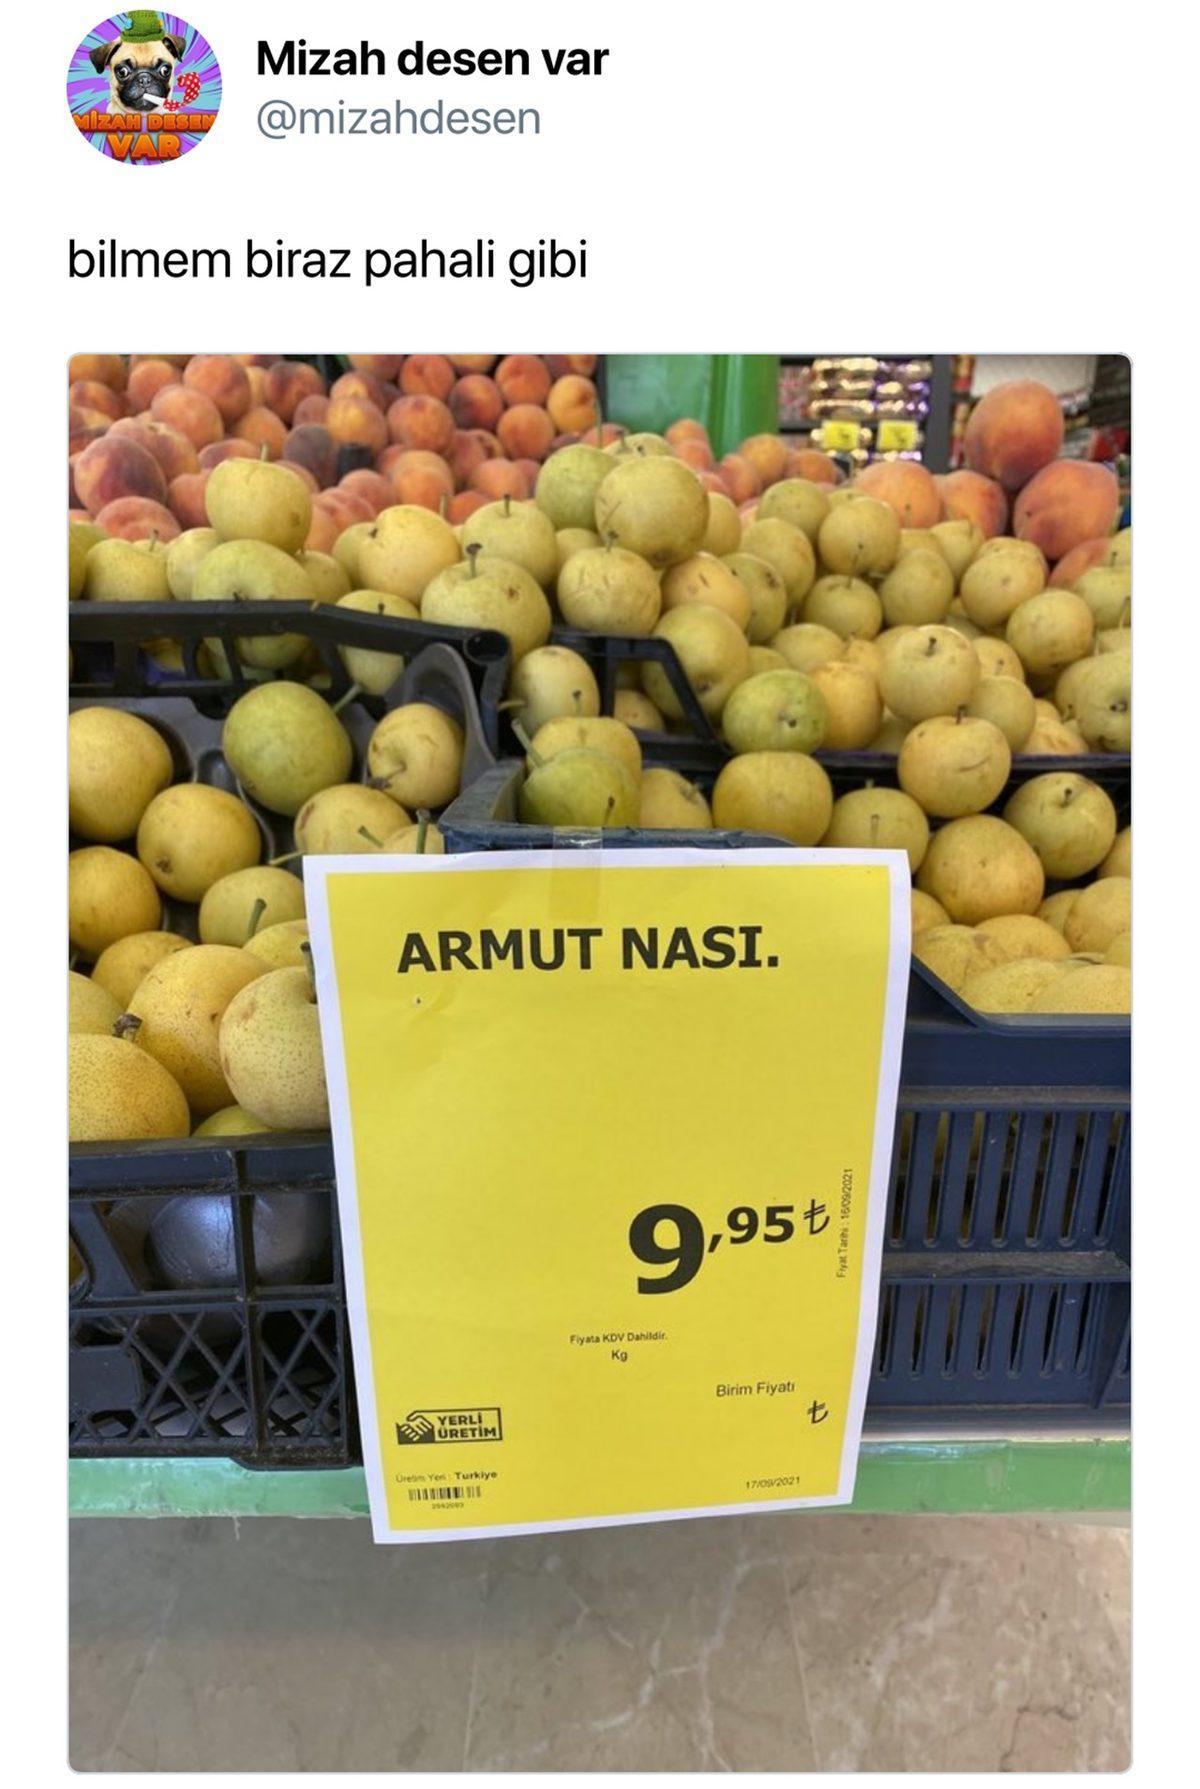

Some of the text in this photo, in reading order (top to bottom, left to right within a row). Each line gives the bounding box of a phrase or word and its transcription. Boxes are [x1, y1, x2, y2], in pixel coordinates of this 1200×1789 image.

[397, 924, 781, 973] ARMUT NASI.
[840, 1168, 853, 1219] 16/09/2021
[569, 1334, 600, 1347] Fiyata
[602, 1333, 625, 1344] KDV
[611, 1349, 628, 1362] Kg
[716, 1383, 753, 1398] Birim
[437, 1412, 482, 1425] YERLİ
[438, 1427, 496, 1439] ÜRETİM
[746, 1476, 800, 1489] 17/09/2021
